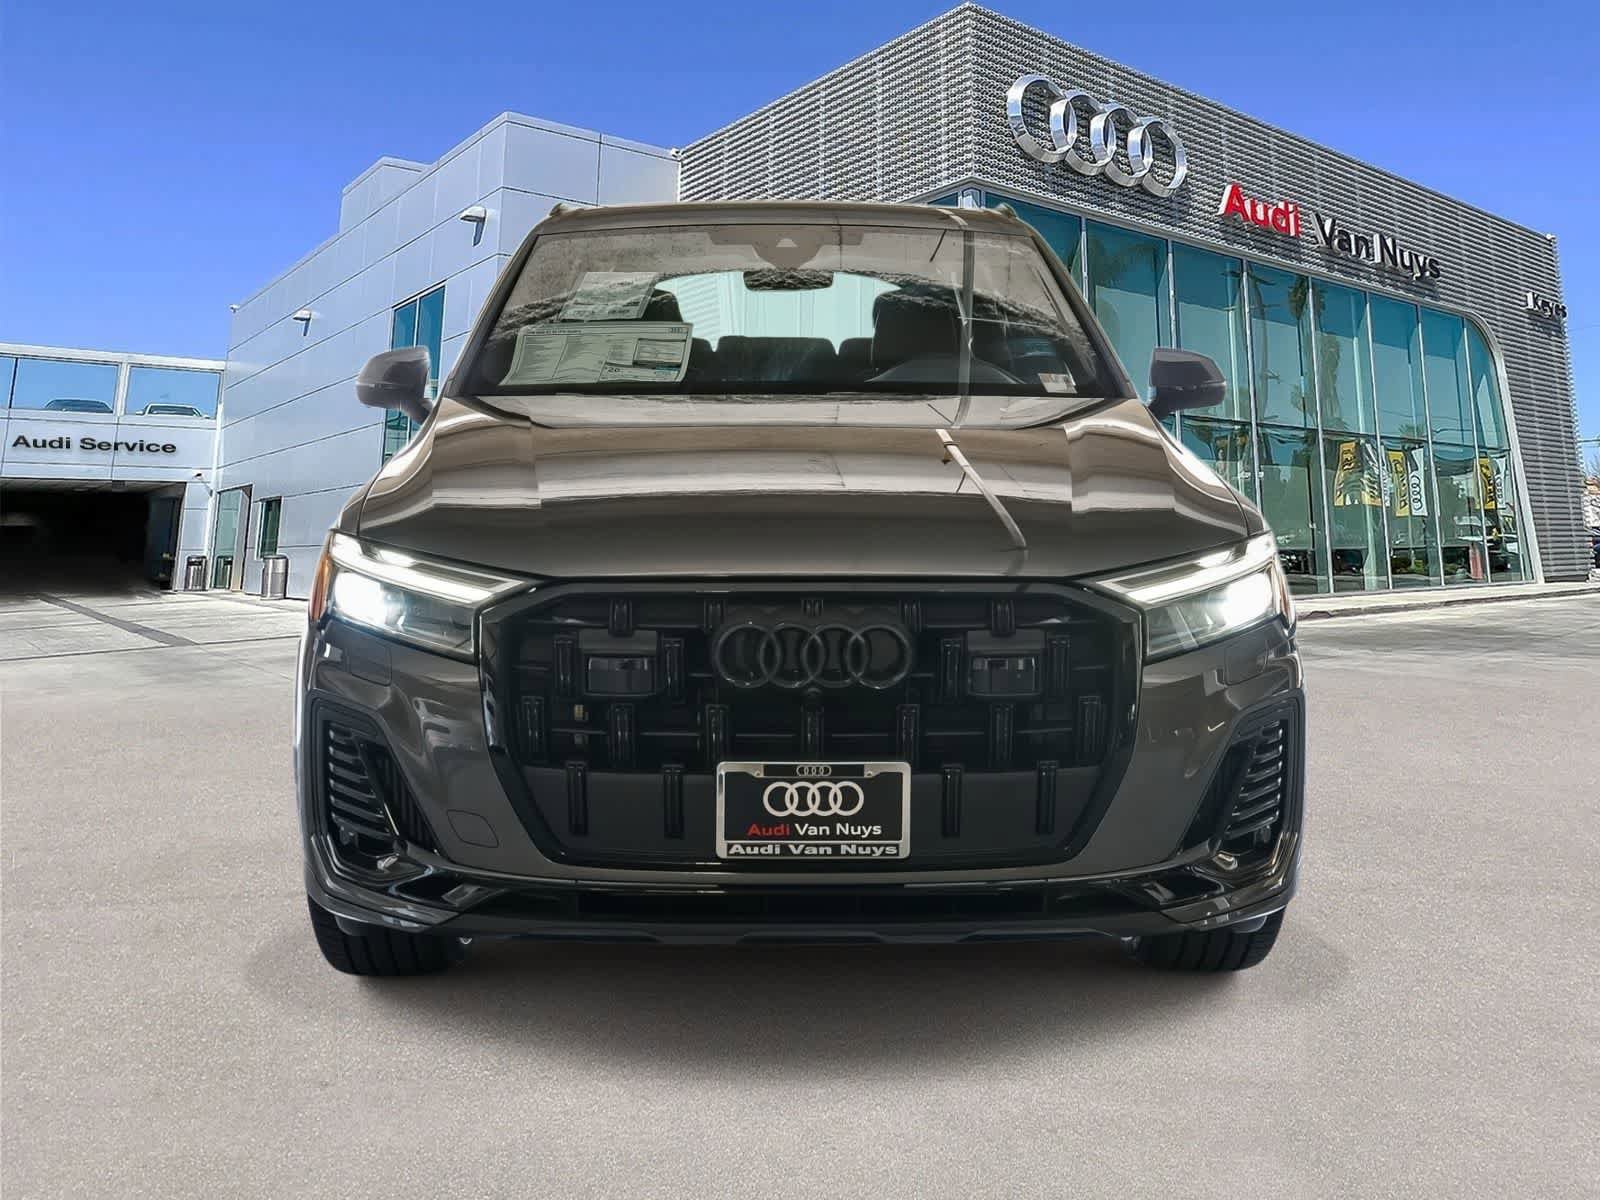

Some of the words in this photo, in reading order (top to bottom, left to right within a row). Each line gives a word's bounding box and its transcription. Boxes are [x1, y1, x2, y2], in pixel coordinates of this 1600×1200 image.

[1219, 182, 1301, 237] Audi
[1312, 212, 1370, 258] Van
[1374, 233, 1441, 280] Nuys
[12, 435, 71, 449] Audi
[79, 437, 177, 453] Service
[747, 824, 790, 836] Audi
[795, 823, 830, 836] Van
[836, 823, 882, 838] Nuys
[729, 844, 780, 855] Audi
[788, 844, 832, 855] Van
[840, 844, 898, 856] Nuys
